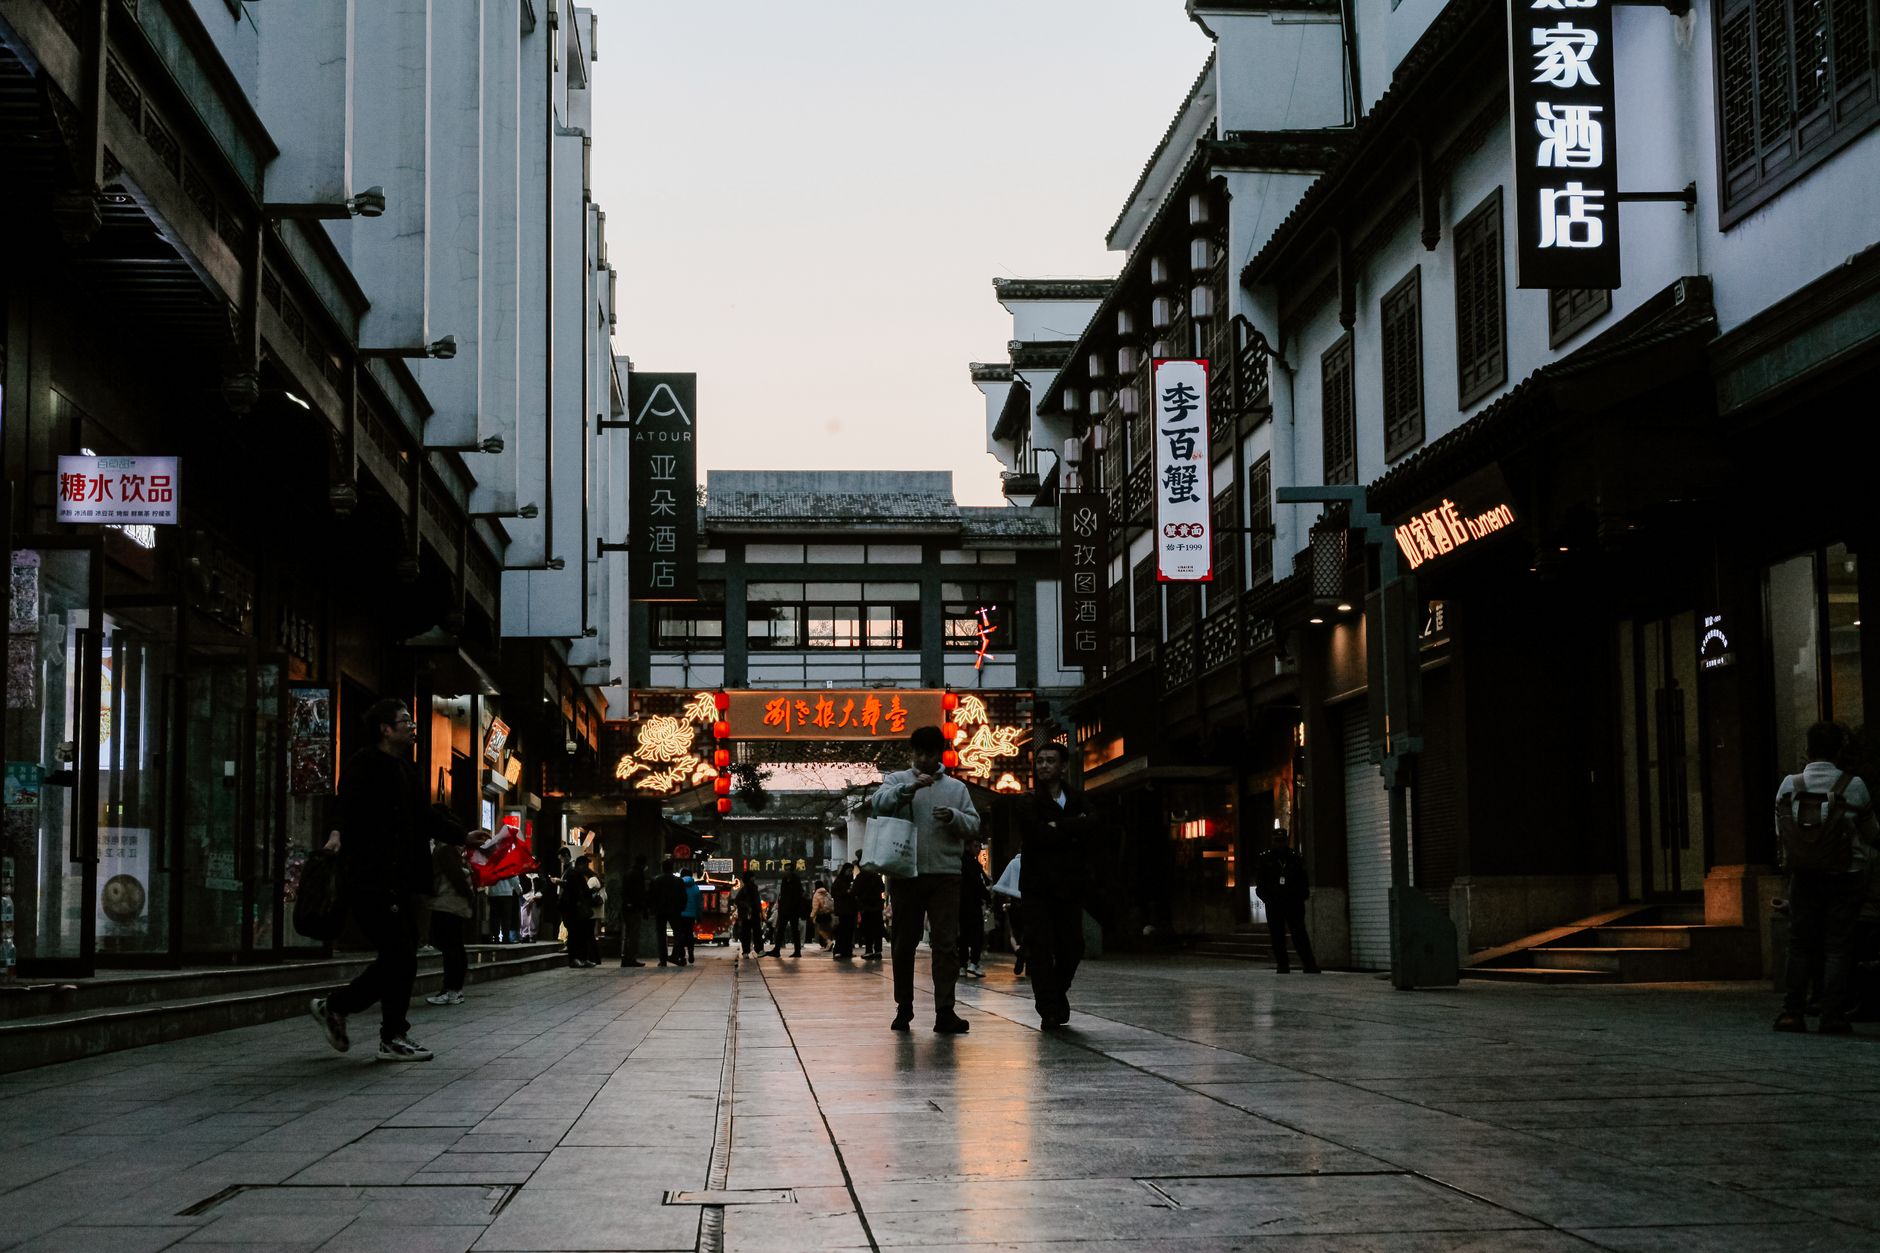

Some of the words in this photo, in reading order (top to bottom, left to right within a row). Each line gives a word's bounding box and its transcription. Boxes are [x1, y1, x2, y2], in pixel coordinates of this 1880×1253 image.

[1531, 0, 1605, 248] 家酒店
[635, 431, 692, 442] ATOUR
[1161, 382, 1200, 504] 李百蟹
[649, 454, 677, 588] 亚朵酒店
[1164, 524, 1204, 537] 蟹黄面
[1395, 498, 1469, 570] 如家酒店
